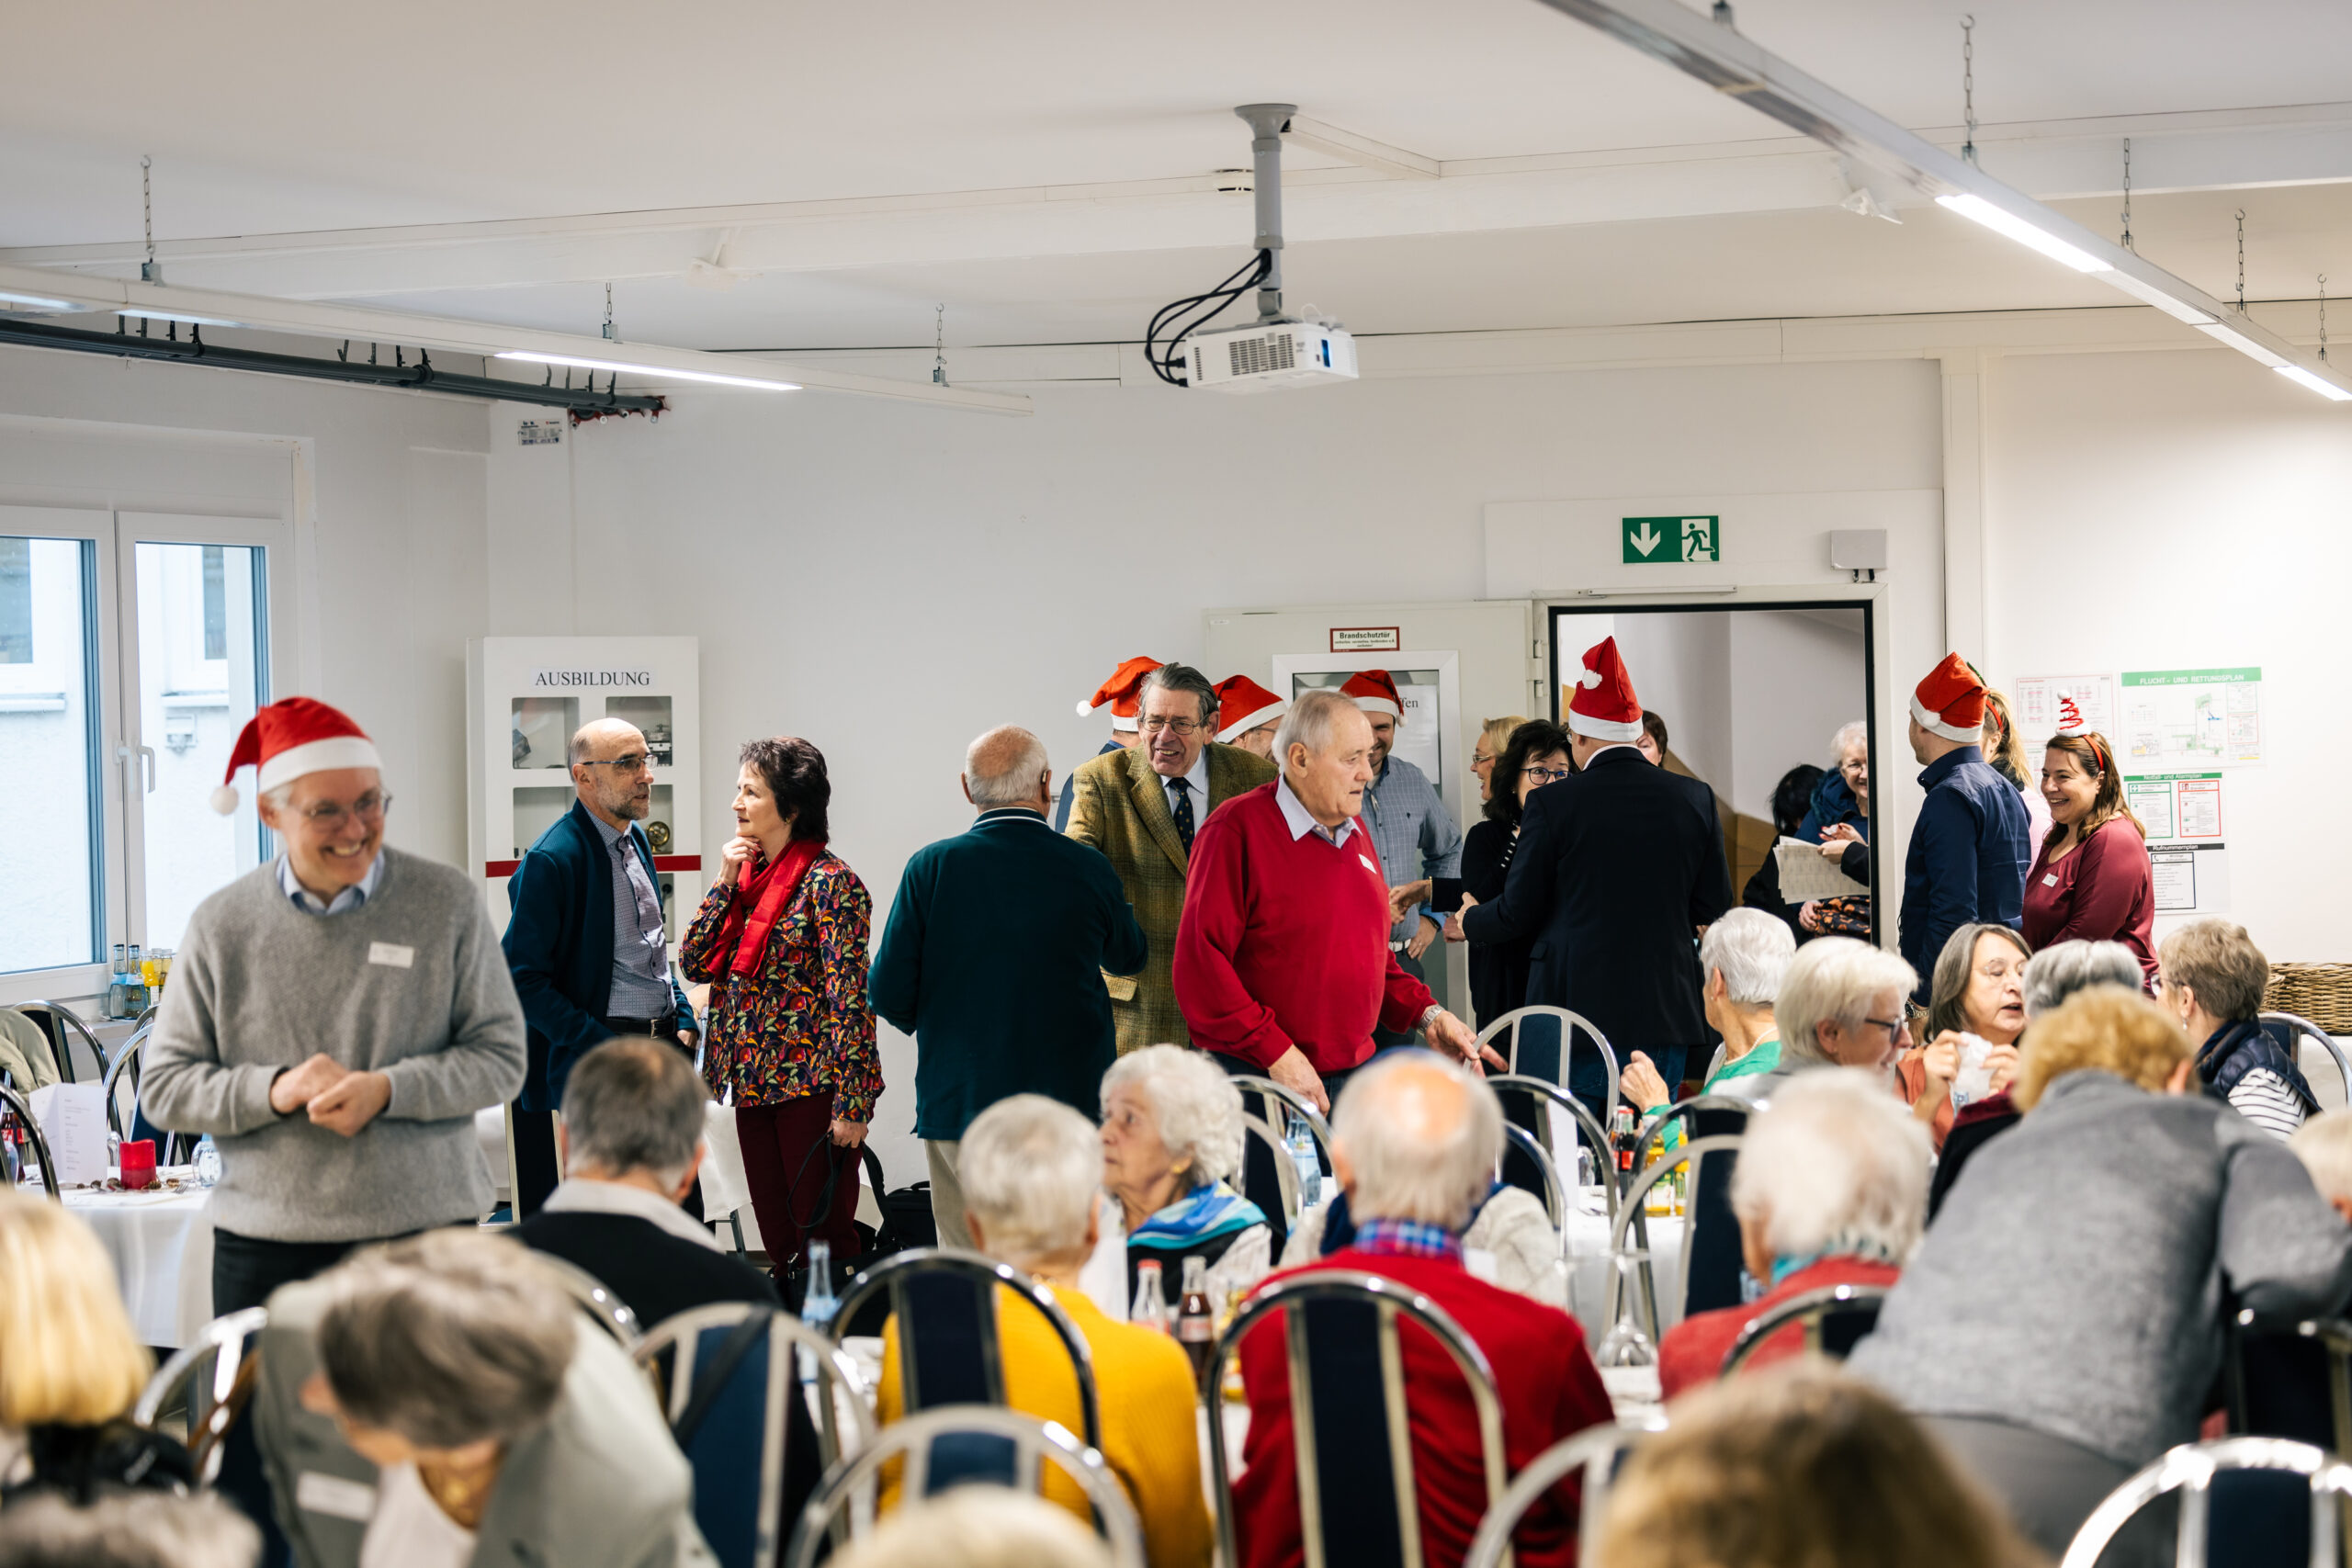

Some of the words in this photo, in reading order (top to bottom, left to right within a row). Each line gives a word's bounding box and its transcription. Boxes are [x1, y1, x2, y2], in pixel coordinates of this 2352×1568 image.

[1340, 631, 1390, 639] Brandschutztür
[536, 671, 650, 686] AUSBILDUNG
[2190, 674, 2245, 683] RETTUNGSPLAN
